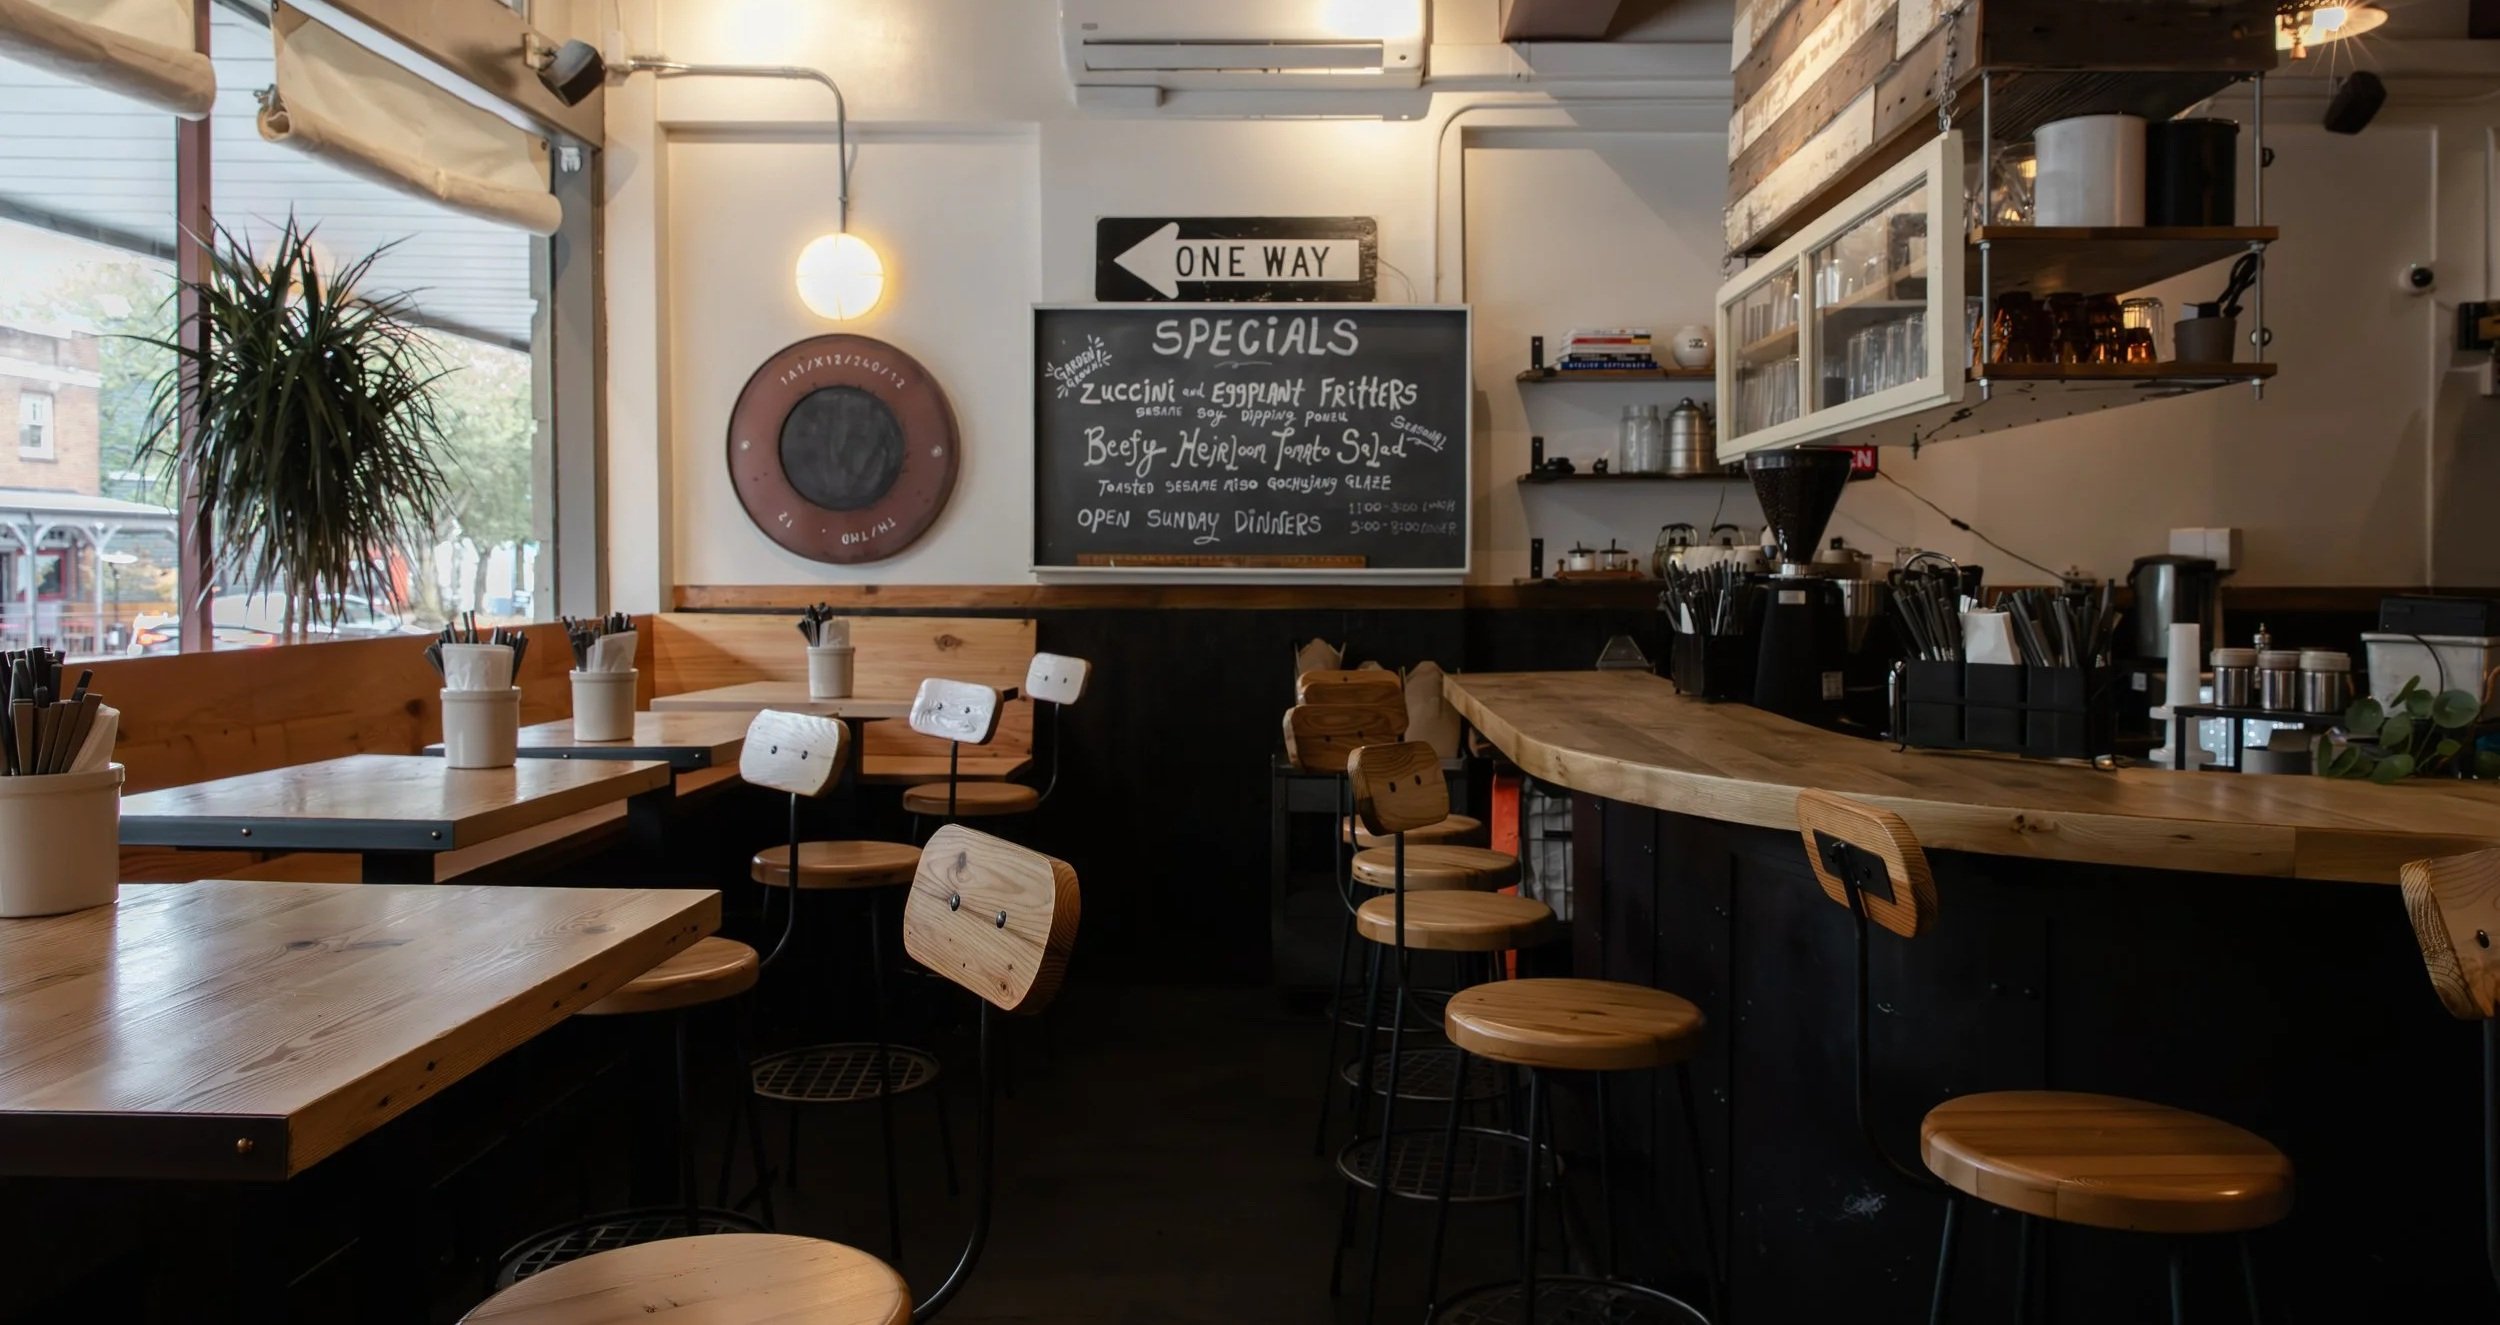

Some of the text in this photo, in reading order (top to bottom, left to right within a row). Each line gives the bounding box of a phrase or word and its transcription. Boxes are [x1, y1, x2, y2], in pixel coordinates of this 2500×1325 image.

[1176, 246, 1330, 277] ONE WAY
[1053, 346, 1096, 380] GARDEN
[1084, 425, 1167, 478] Beefy
[1336, 428, 1407, 468] Salad
[1165, 479, 1218, 493] SESAME
[1345, 474, 1392, 491] GLAZE
[1077, 508, 1130, 533] OPEN
